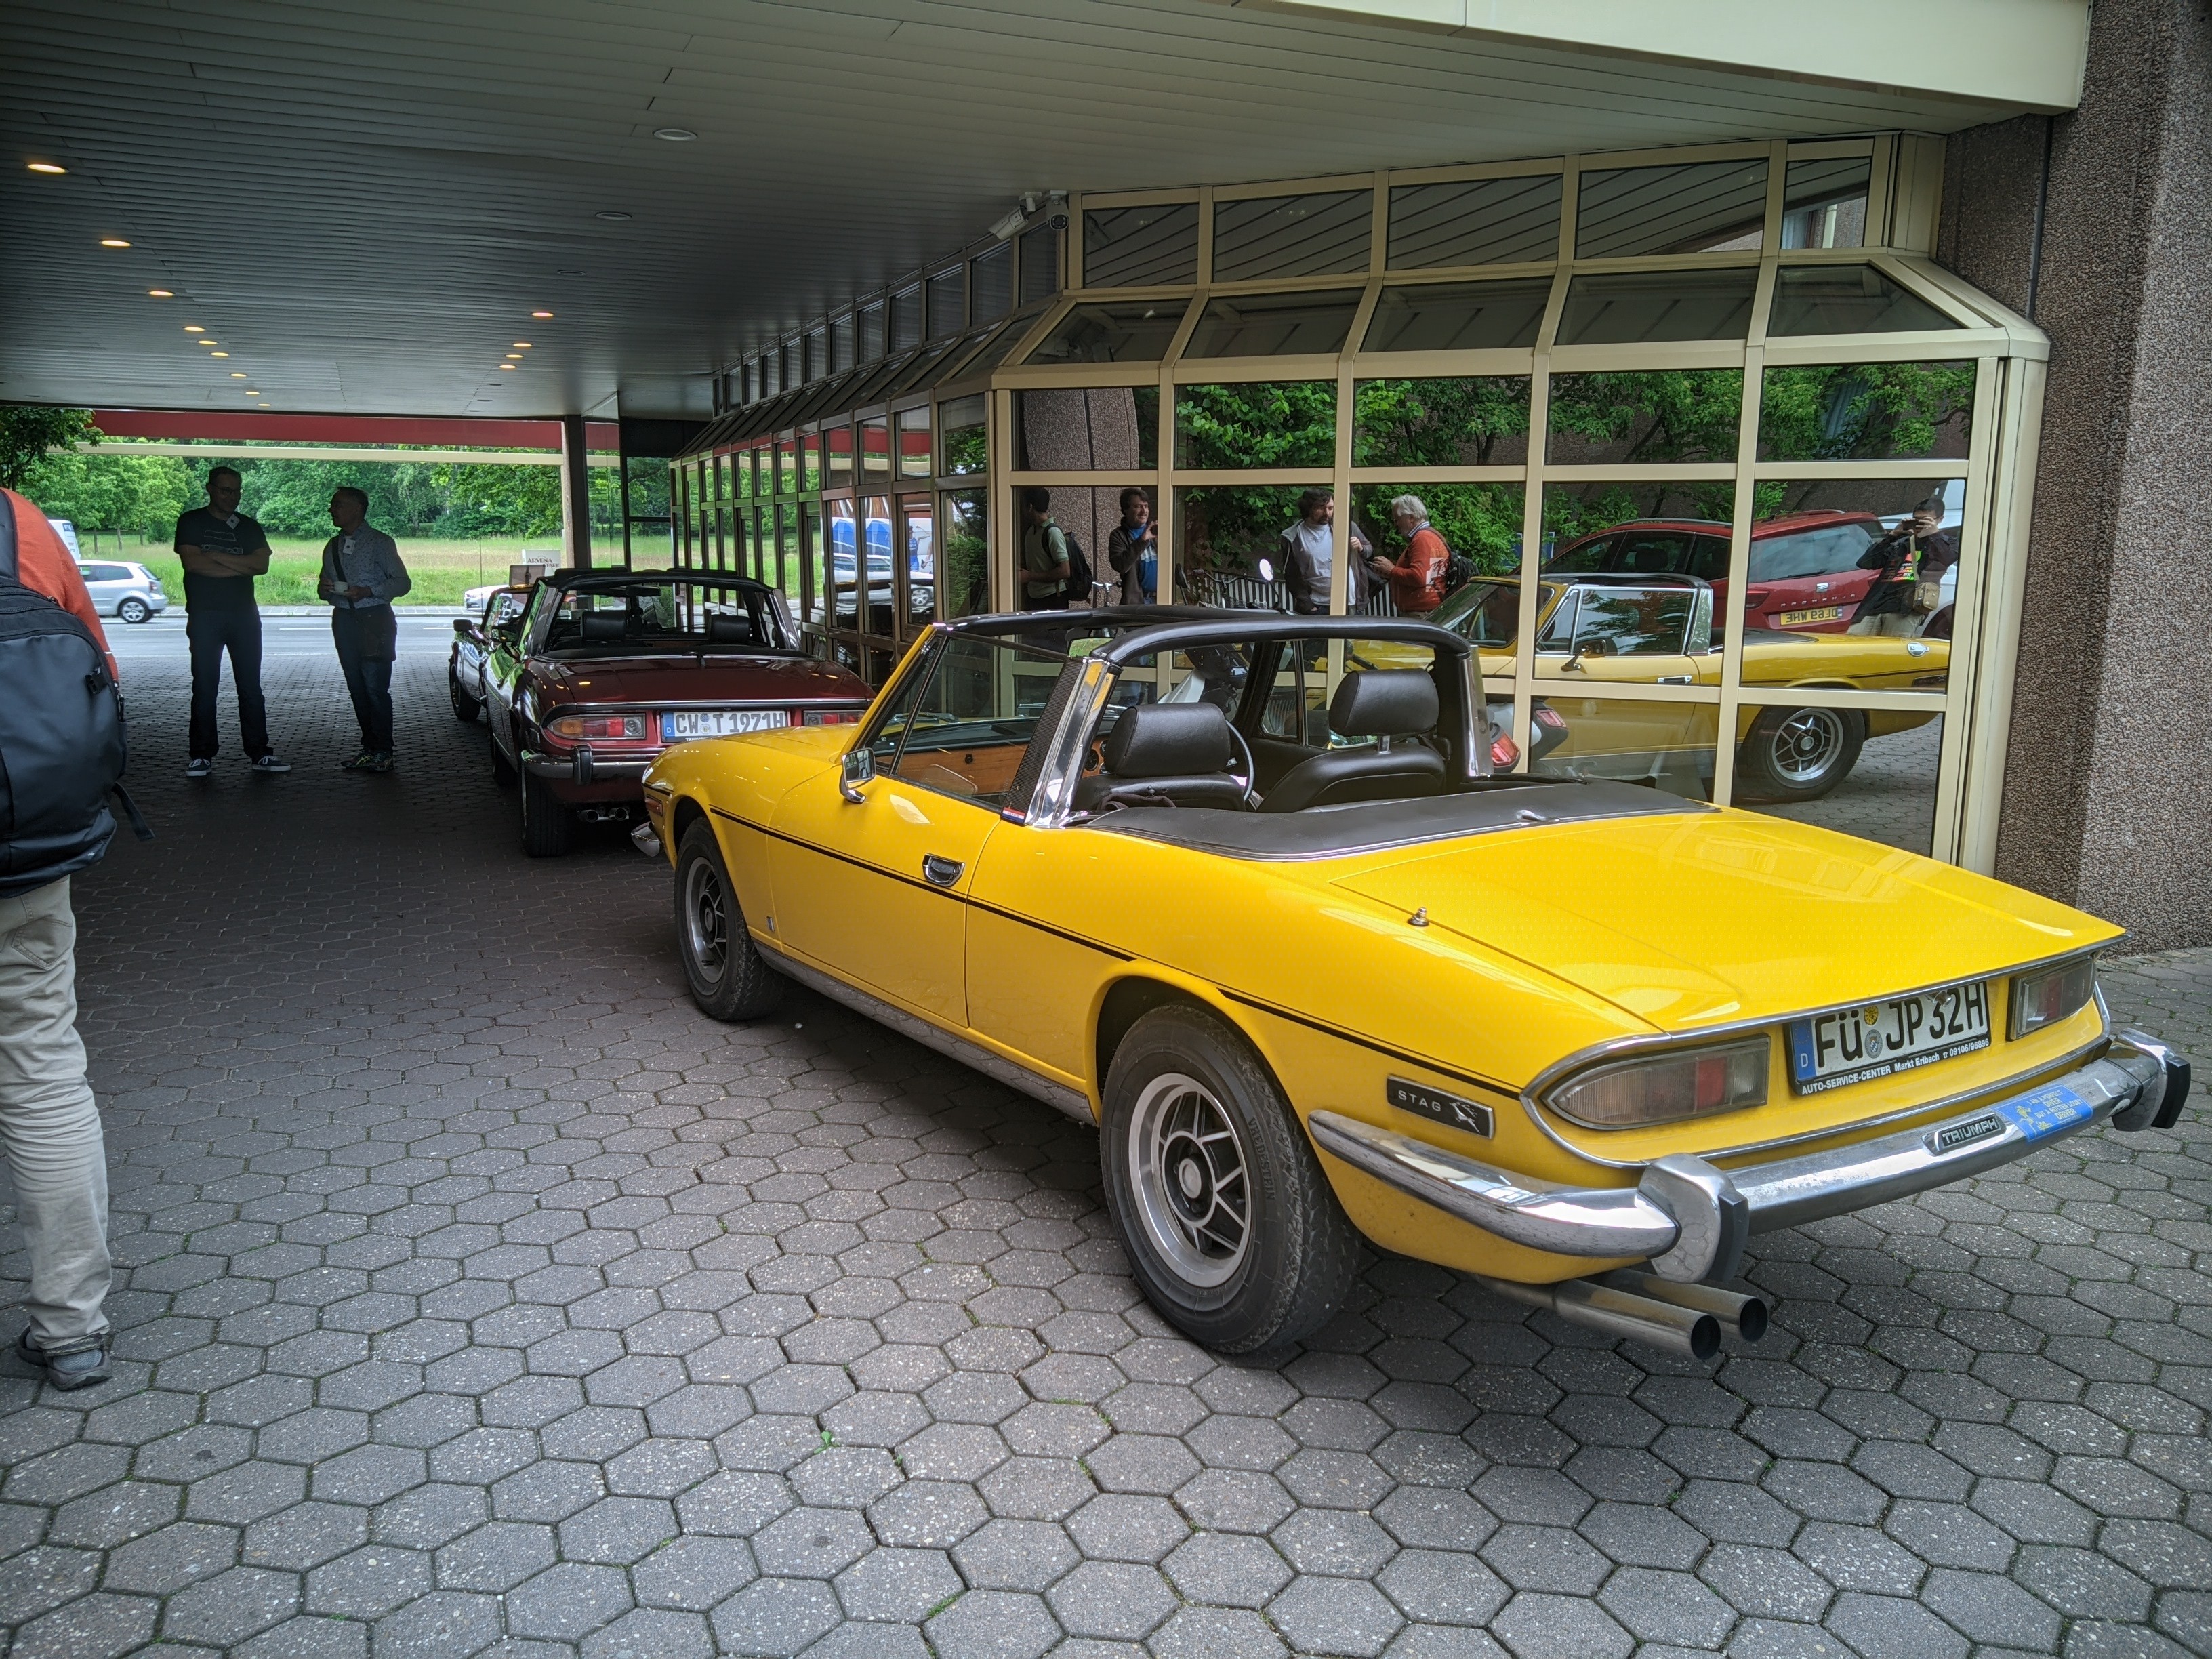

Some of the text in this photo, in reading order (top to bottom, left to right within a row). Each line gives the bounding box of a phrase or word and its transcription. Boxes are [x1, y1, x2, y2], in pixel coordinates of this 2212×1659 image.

[675, 713, 783, 733] CW T 1971H
[1814, 985, 1984, 1068] FÜ JP 32H
[1800, 1053, 1809, 1067] D
[1801, 1038, 1990, 1096] AUTO-SERVICE-CENTER Markt Erlbach 09106/96896
[1398, 1090, 1441, 1112] STAG
[2041, 1090, 2064, 1100] PERFECT
[2042, 1097, 2063, 1107] DIVER
[2049, 1103, 2070, 1113] ROTTEN
[2054, 1108, 2078, 1120] DRIVER
[1942, 1118, 1999, 1144] TRIUMPH
[1248, 1116, 1275, 1200] VREDESTEIN
